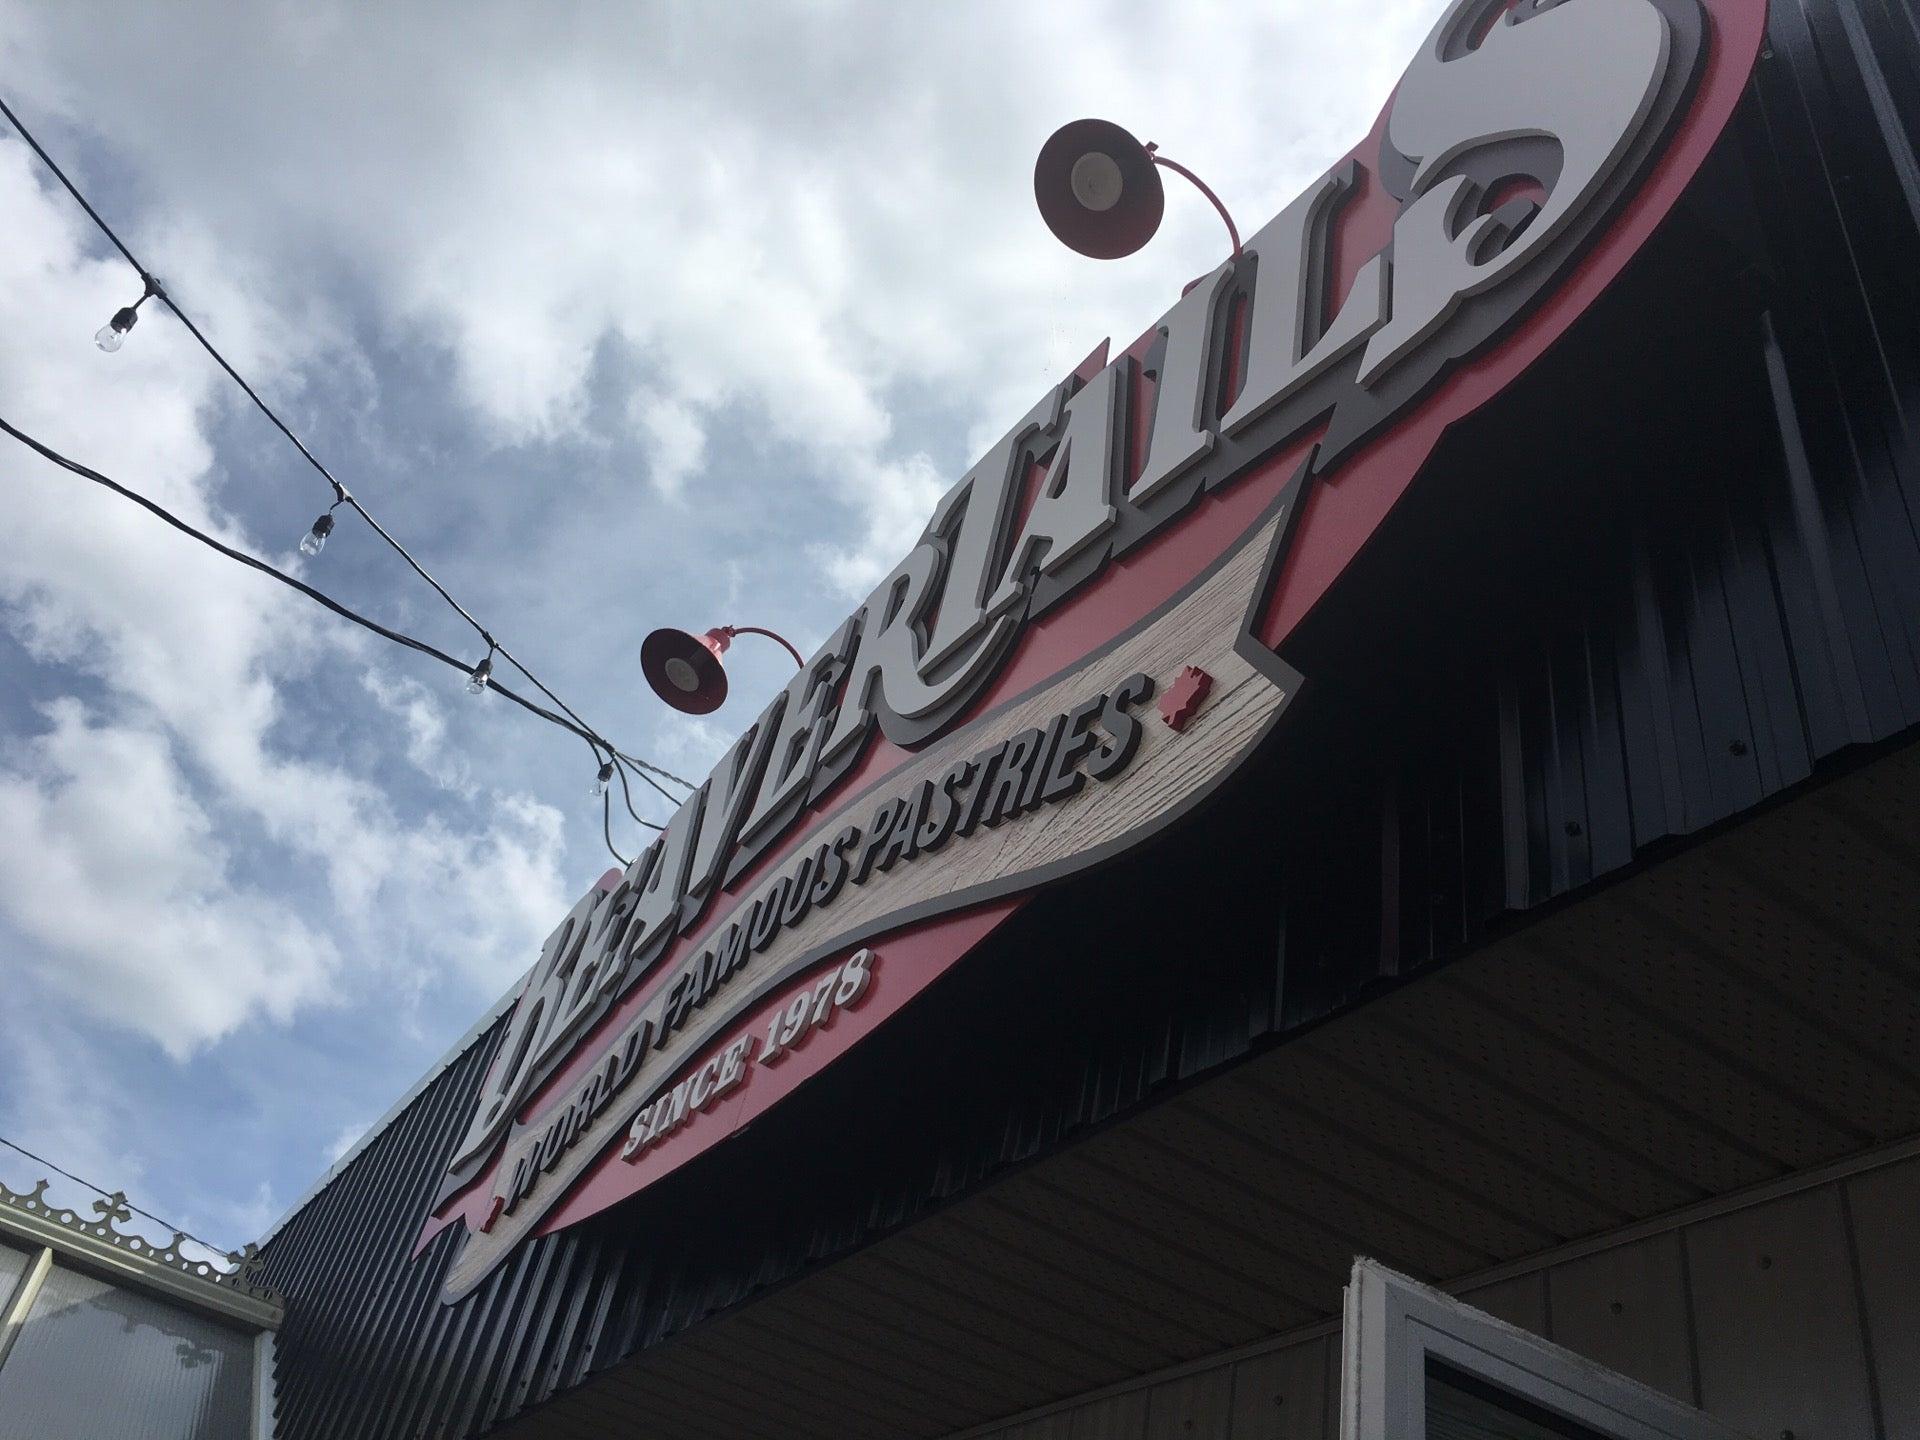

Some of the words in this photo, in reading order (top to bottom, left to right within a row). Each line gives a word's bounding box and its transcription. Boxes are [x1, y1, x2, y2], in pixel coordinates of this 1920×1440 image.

[447, 0, 1672, 1174] BEAVERTAILS
[503, 1020, 653, 1215] WORLD
[653, 826, 861, 1050] FAMOUS
[850, 672, 1155, 885] PASTRIES
[620, 1034, 756, 1163] SINCE
[758, 948, 875, 1065] 1978
